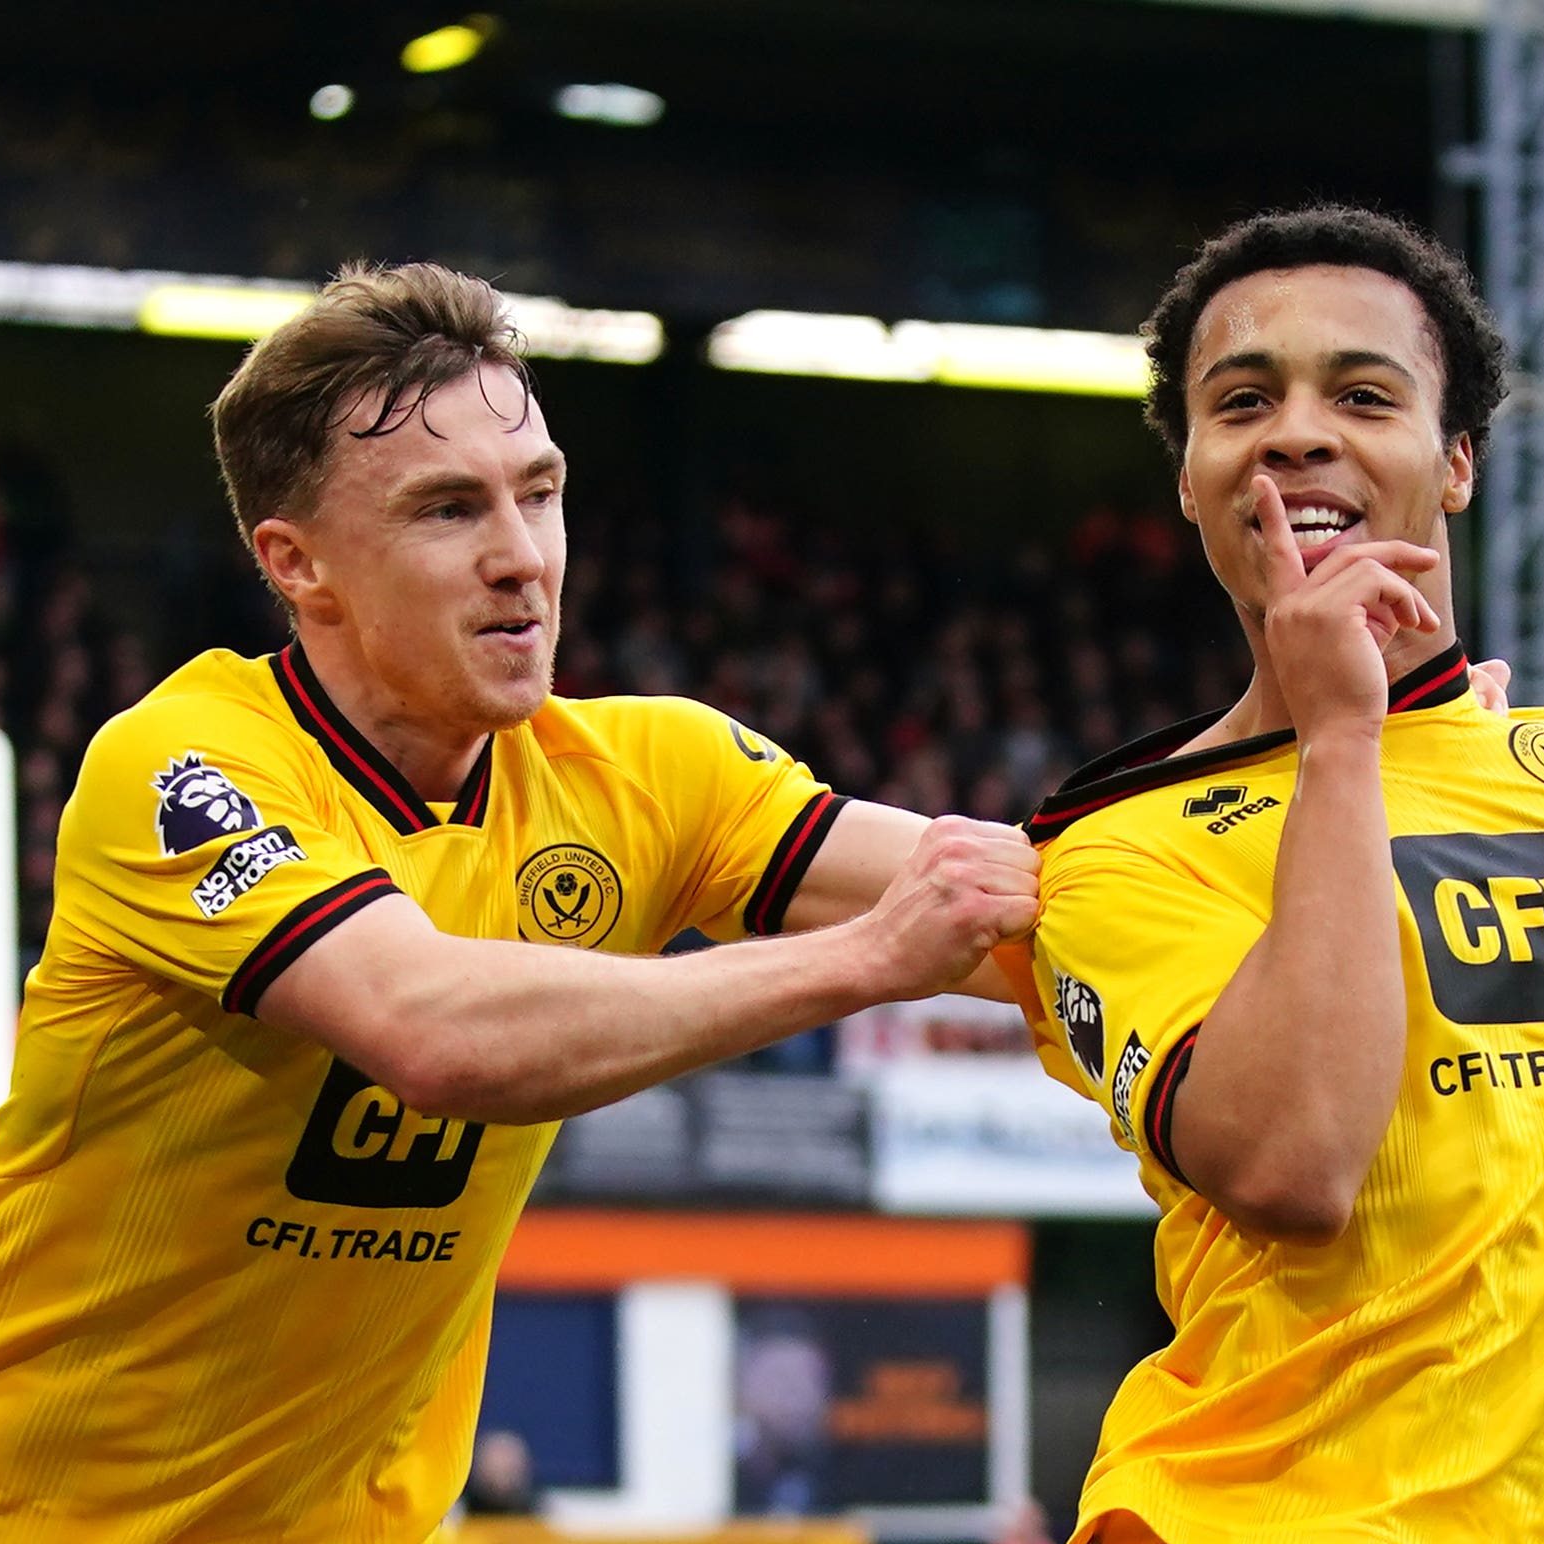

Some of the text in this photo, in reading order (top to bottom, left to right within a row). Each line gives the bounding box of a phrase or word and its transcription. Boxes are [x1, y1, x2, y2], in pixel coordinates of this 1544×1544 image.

[193, 831, 286, 906] No room
[519, 851, 615, 906] SHEFFIELD UNITED F.C.
[201, 883, 236, 918] for
[330, 1084, 467, 1163] CFI
[246, 1217, 462, 1263] CFI.TRADE
